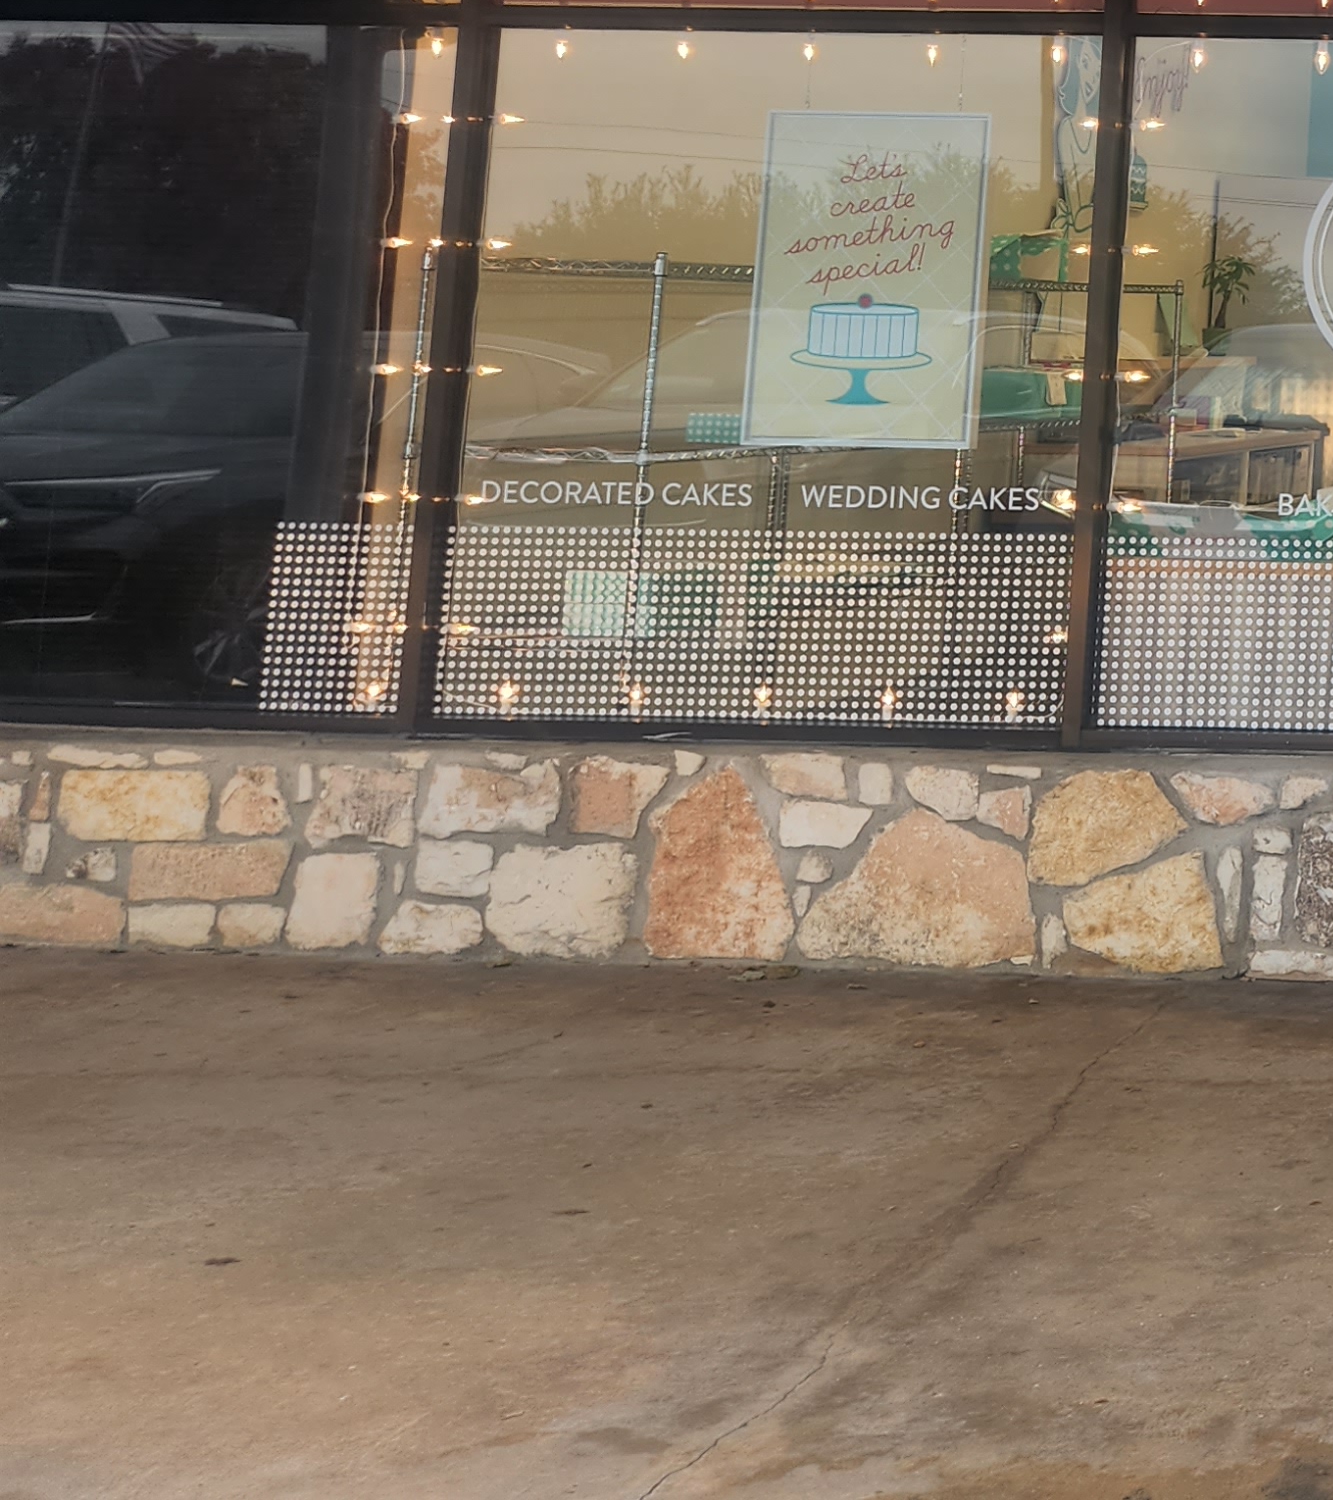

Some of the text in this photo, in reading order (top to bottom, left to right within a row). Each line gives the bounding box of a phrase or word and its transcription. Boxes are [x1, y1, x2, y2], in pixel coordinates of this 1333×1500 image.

[841, 151, 908, 184] Let's
[830, 181, 916, 217] create
[784, 214, 955, 255] something
[805, 242, 926, 297] special!
[481, 479, 752, 507] DECORATED CAKES
[800, 483, 1040, 512] WEDDING CAKES
